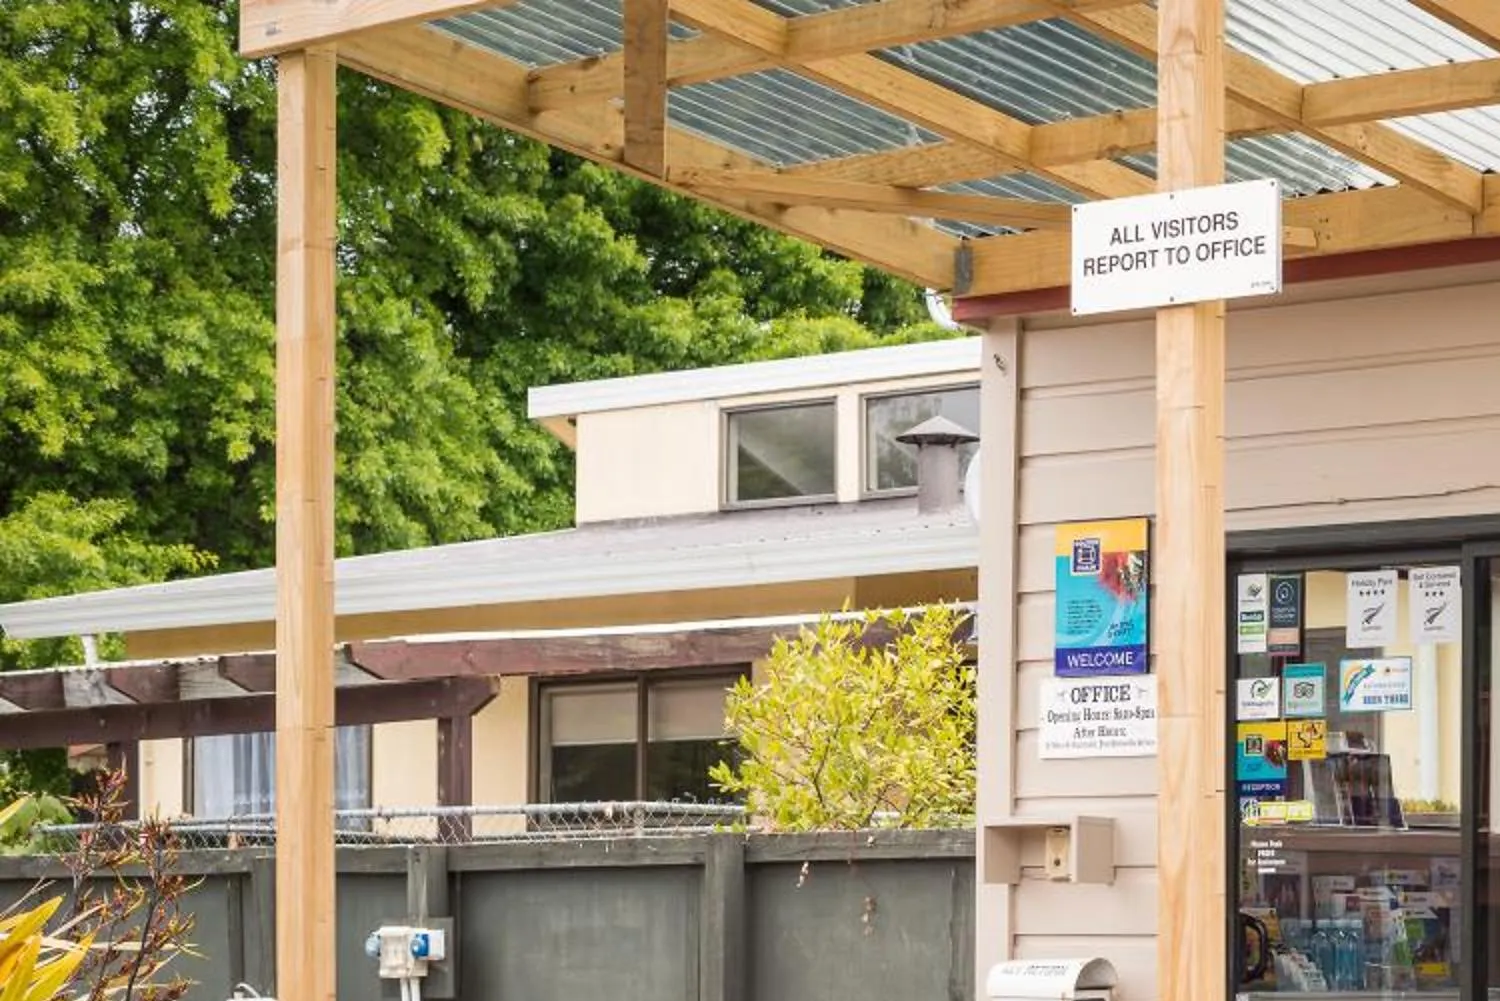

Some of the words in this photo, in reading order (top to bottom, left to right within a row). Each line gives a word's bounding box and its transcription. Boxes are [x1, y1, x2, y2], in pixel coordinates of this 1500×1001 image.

[1109, 225, 1145, 246] ALL
[1150, 211, 1239, 240] VISITORS
[1083, 250, 1159, 277] REPORT
[1164, 246, 1191, 266] TO
[1195, 235, 1266, 262] OFFICE
[1066, 651, 1134, 668] WELCOME
[1070, 684, 1131, 704] OFFICE
